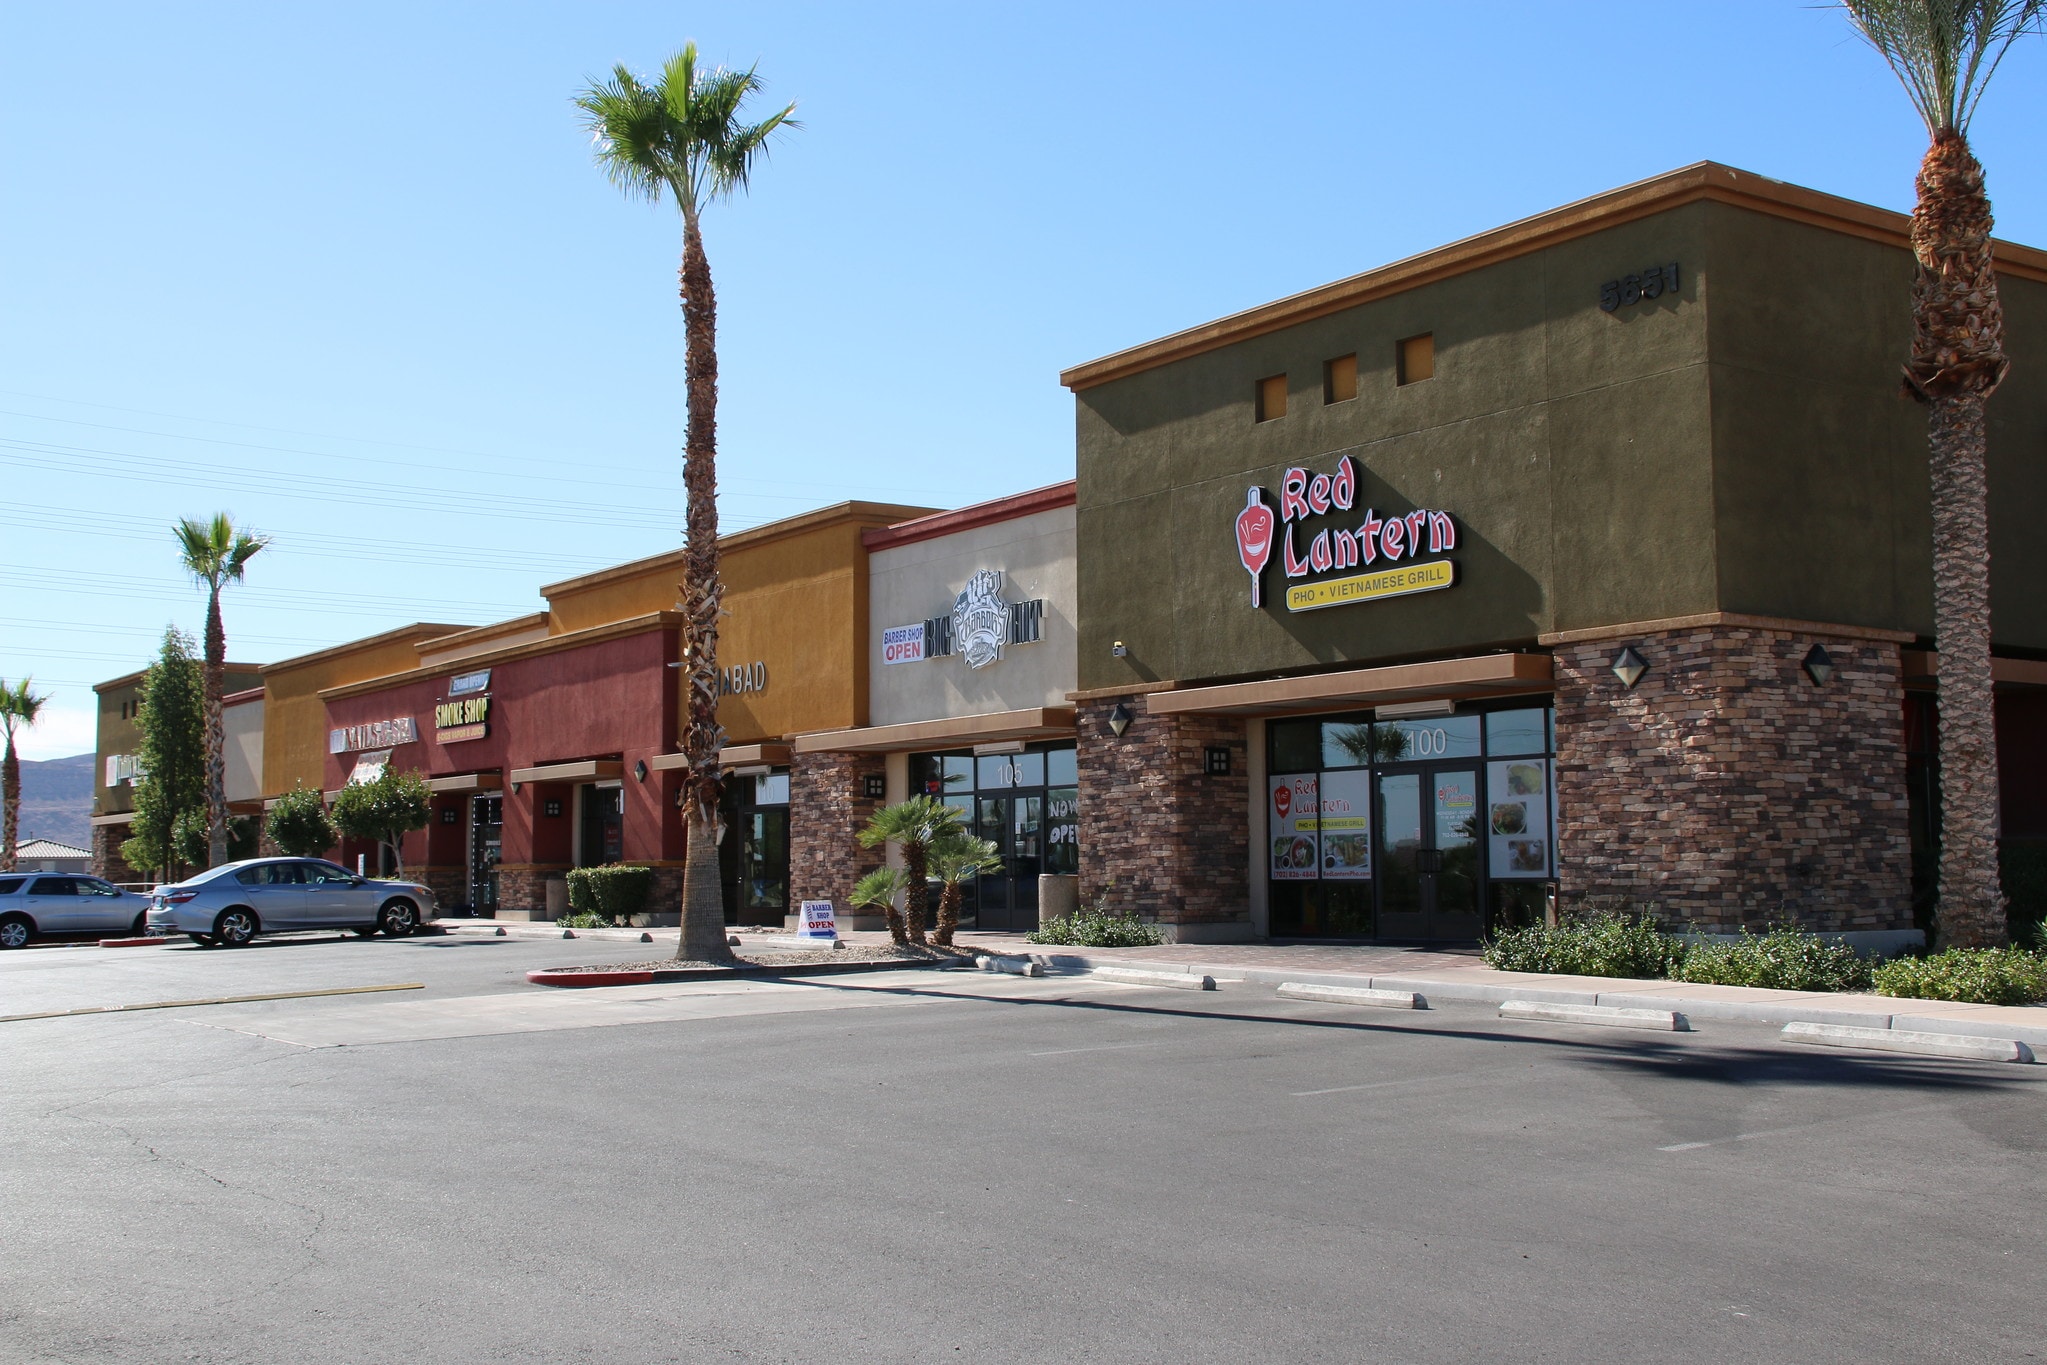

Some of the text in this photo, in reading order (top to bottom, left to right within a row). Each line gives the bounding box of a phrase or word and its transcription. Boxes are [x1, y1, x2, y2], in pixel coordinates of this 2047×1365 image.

[1600, 262, 1678, 312] 5651
[1280, 454, 1356, 524] Red
[1283, 507, 1456, 578] Lantern
[1293, 567, 1444, 604] PHO VIETNAMESE GRILL
[884, 627, 924, 645] BARBER SHOP
[924, 615, 951, 659] BIG
[885, 641, 921, 661] OPEN
[435, 697, 488, 729] SMOKE SHOP
[1407, 728, 1448, 756] 100
[997, 763, 1023, 785] 105
[1294, 777, 1318, 795] Red
[1050, 798, 1079, 817] NOW
[811, 904, 832, 912] BARBER
[816, 912, 830, 920] SHOP
[808, 921, 835, 929] OPEN
